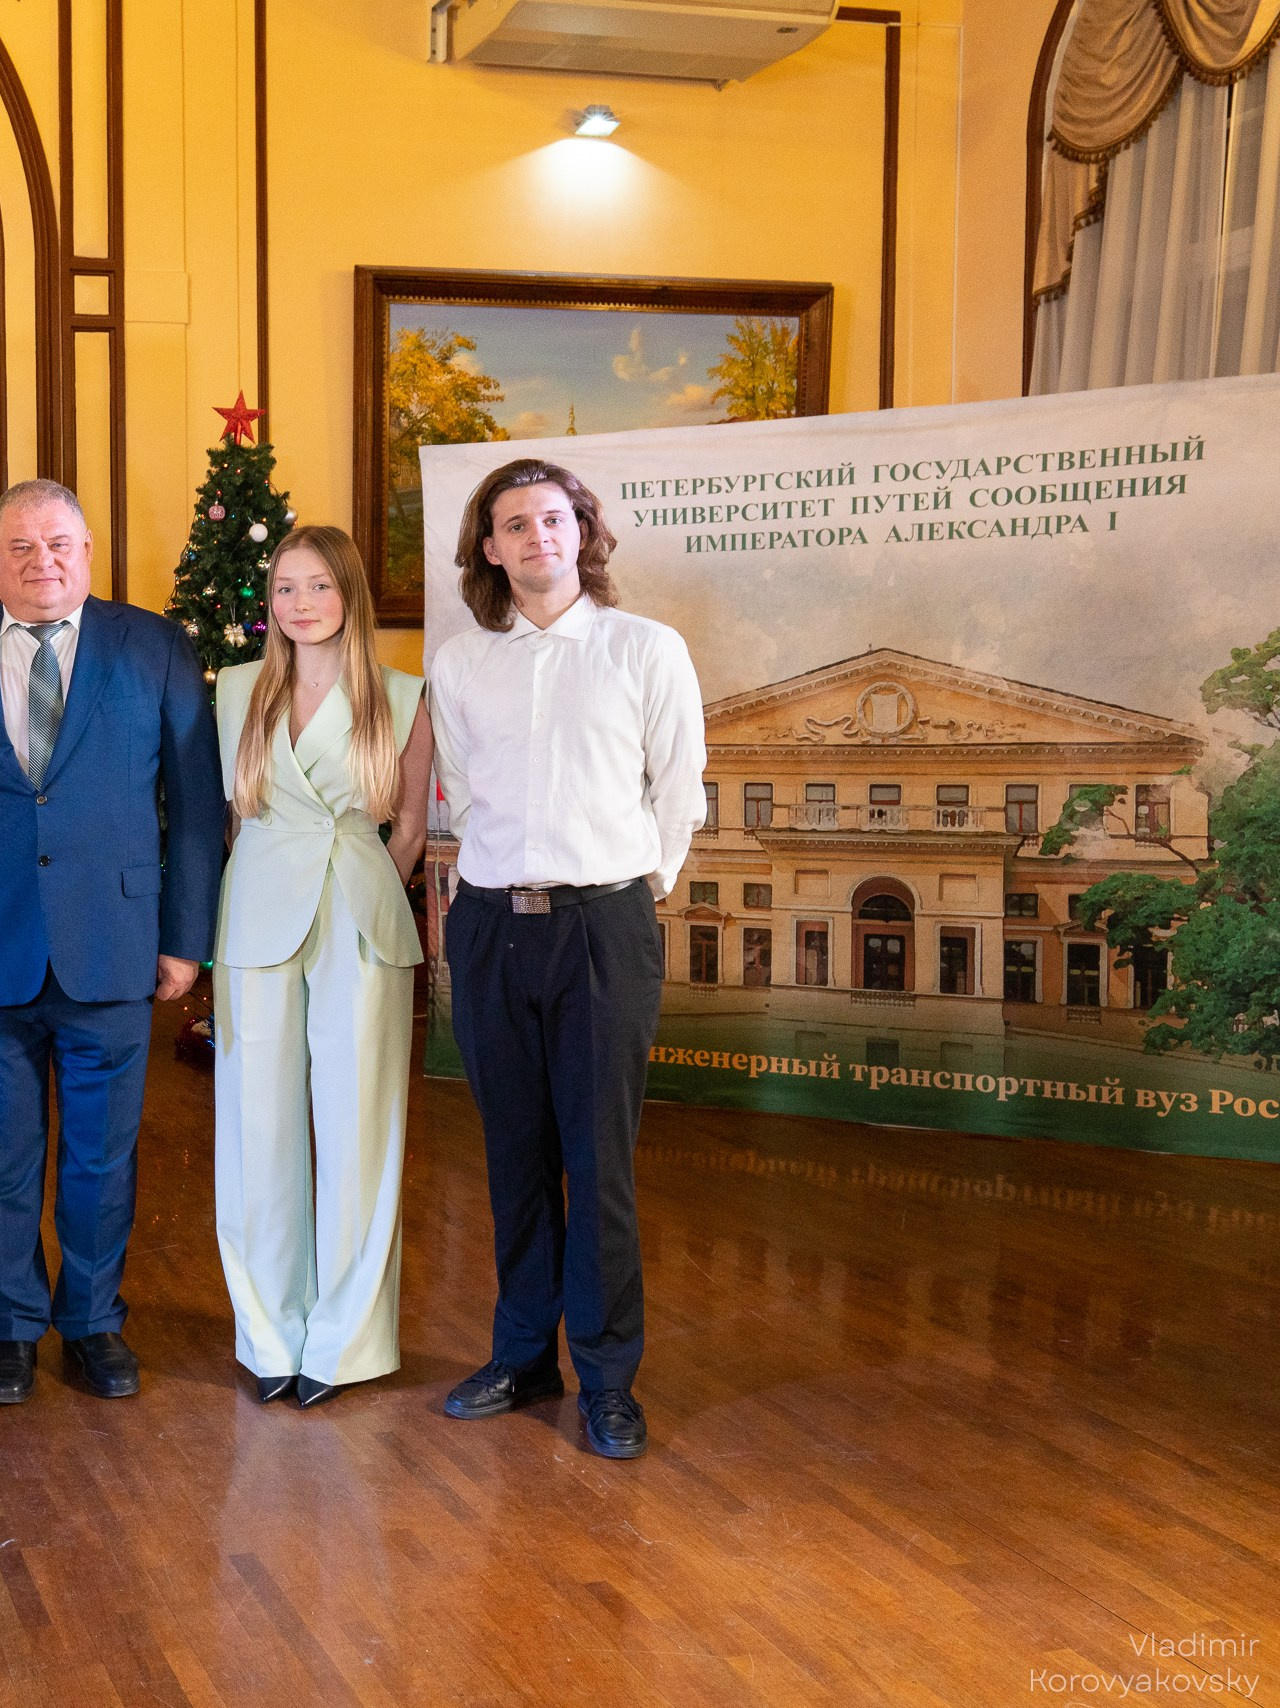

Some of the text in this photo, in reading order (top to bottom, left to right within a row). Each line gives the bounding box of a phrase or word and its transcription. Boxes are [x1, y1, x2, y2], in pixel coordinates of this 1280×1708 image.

[620, 434, 1206, 500] ПЕТЕРБУРГСКИЙ ГОСУДАРСТВЕННЫЙ
[633, 473, 1189, 528] УНИВЕРСИТЕТ ПУТЕЙ СООБЩЕНИЯ
[685, 511, 1120, 554] ИМПЕРАТОРА АЛЕКСАНДРА I
[648, 1045, 841, 1079] нженерный
[849, 1063, 1125, 1105] транспортный
[1135, 1088, 1199, 1118] вуз
